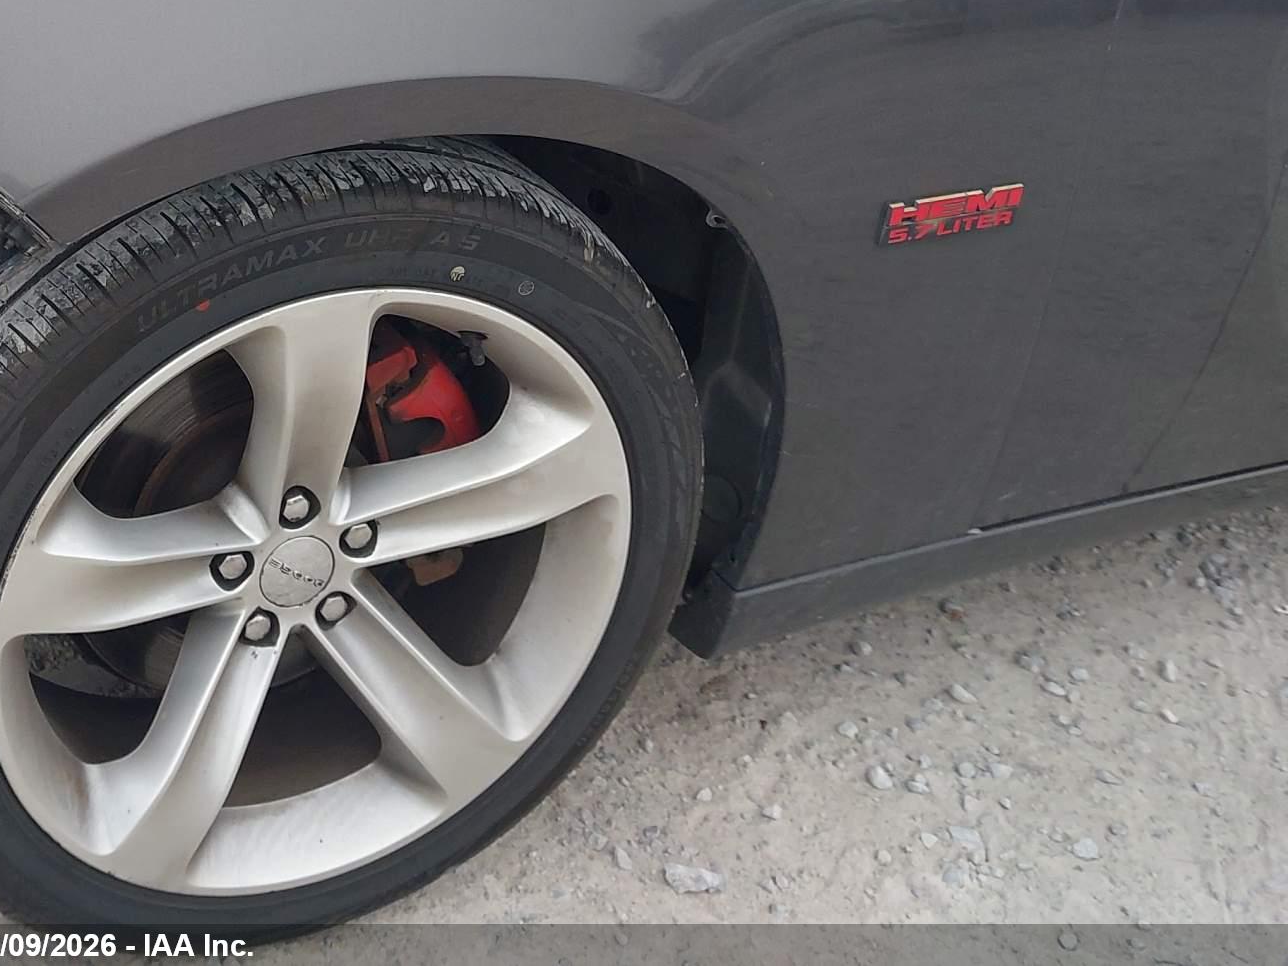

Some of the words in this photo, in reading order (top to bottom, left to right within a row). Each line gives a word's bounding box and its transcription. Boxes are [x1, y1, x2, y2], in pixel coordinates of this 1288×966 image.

[889, 183, 1025, 225] HEMI
[887, 223, 936, 244] 5.7
[936, 210, 1013, 237] LITER
[137, 236, 327, 333] ULTRAMAX
